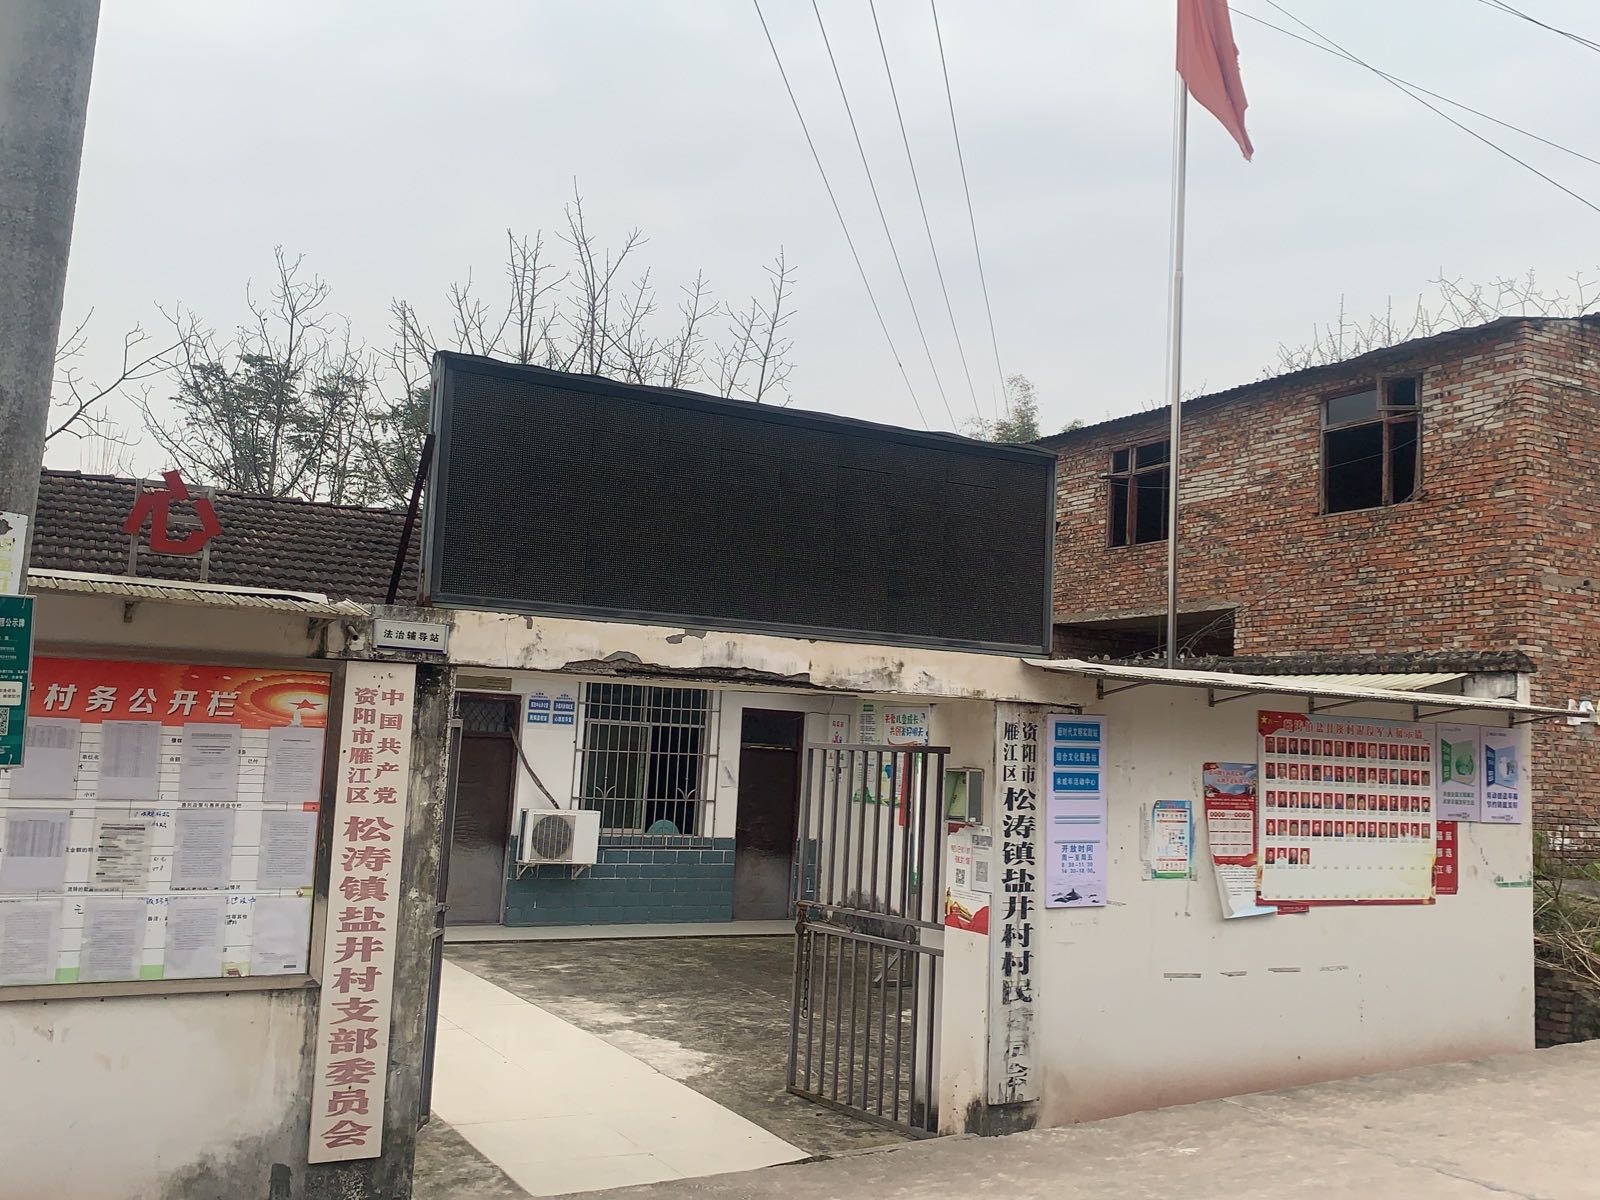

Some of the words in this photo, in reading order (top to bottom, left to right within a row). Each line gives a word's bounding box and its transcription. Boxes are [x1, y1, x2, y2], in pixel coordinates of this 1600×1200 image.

[122, 469, 223, 554] 心
[383, 629, 440, 643] 法治辅导站
[29, 683, 242, 717] 村务公开栏
[346, 687, 378, 804] 资阳市雁江区
[373, 689, 405, 805] 中国共产党
[1003, 721, 1020, 783] 雁江区
[1021, 721, 1038, 782] 资阳市
[1056, 777, 1096, 786] 未成年活动中心
[321, 816, 392, 1149] 松涛镇盐井村支部委员会
